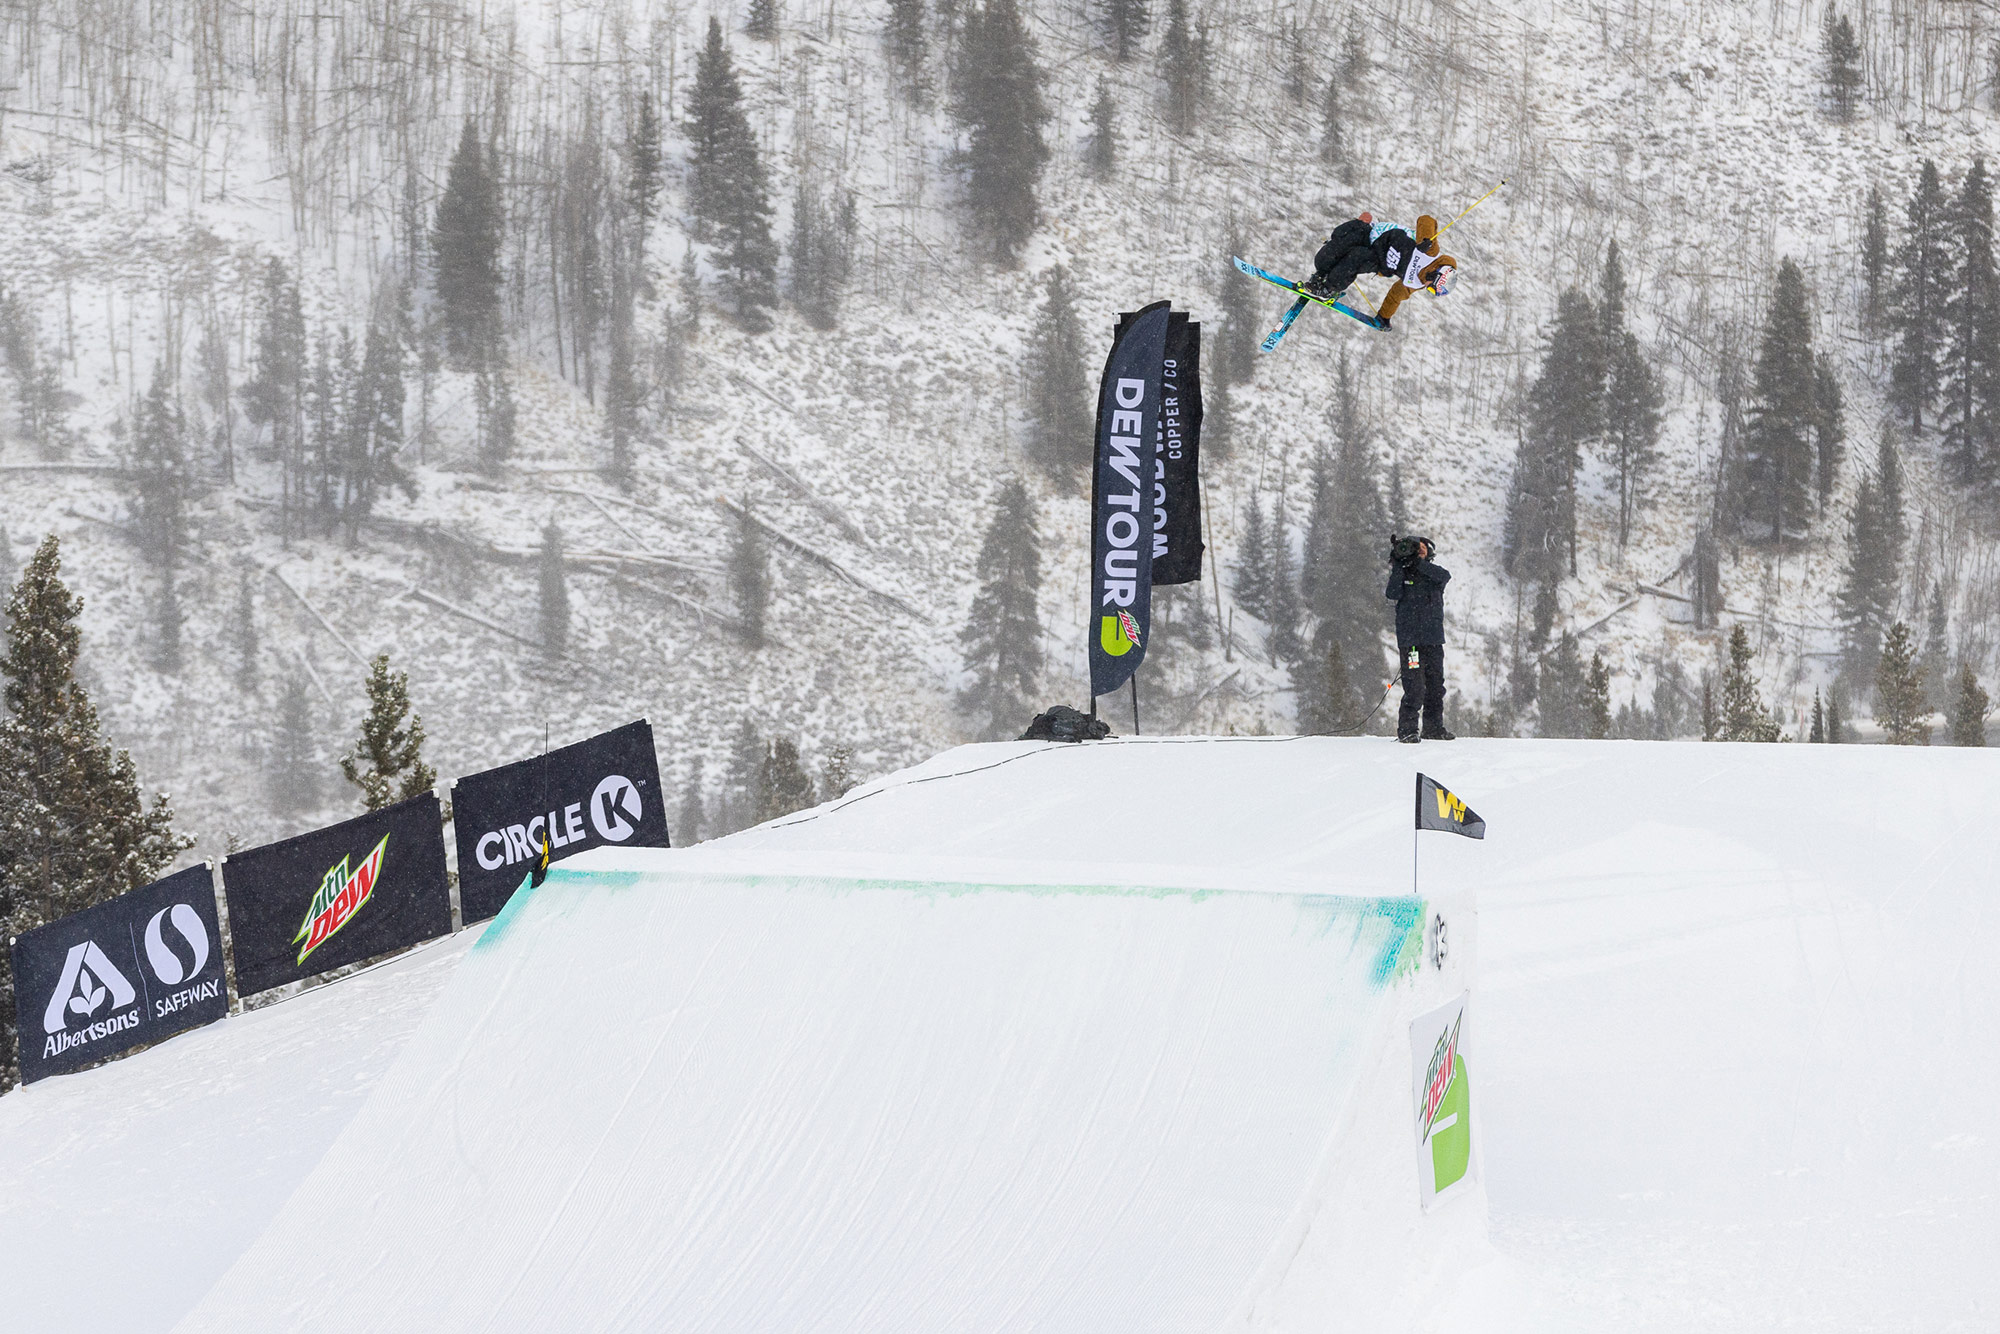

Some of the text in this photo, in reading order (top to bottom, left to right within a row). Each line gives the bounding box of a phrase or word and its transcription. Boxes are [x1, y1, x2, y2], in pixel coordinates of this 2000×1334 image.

[1164, 359, 1177, 378] CO
[1165, 397, 1182, 459] COPPER
[475, 802, 587, 871] CIRCLE
[597, 781, 642, 836] K
[155, 978, 219, 1018] SAFEWAY
[42, 1009, 140, 1060] Albertsons
